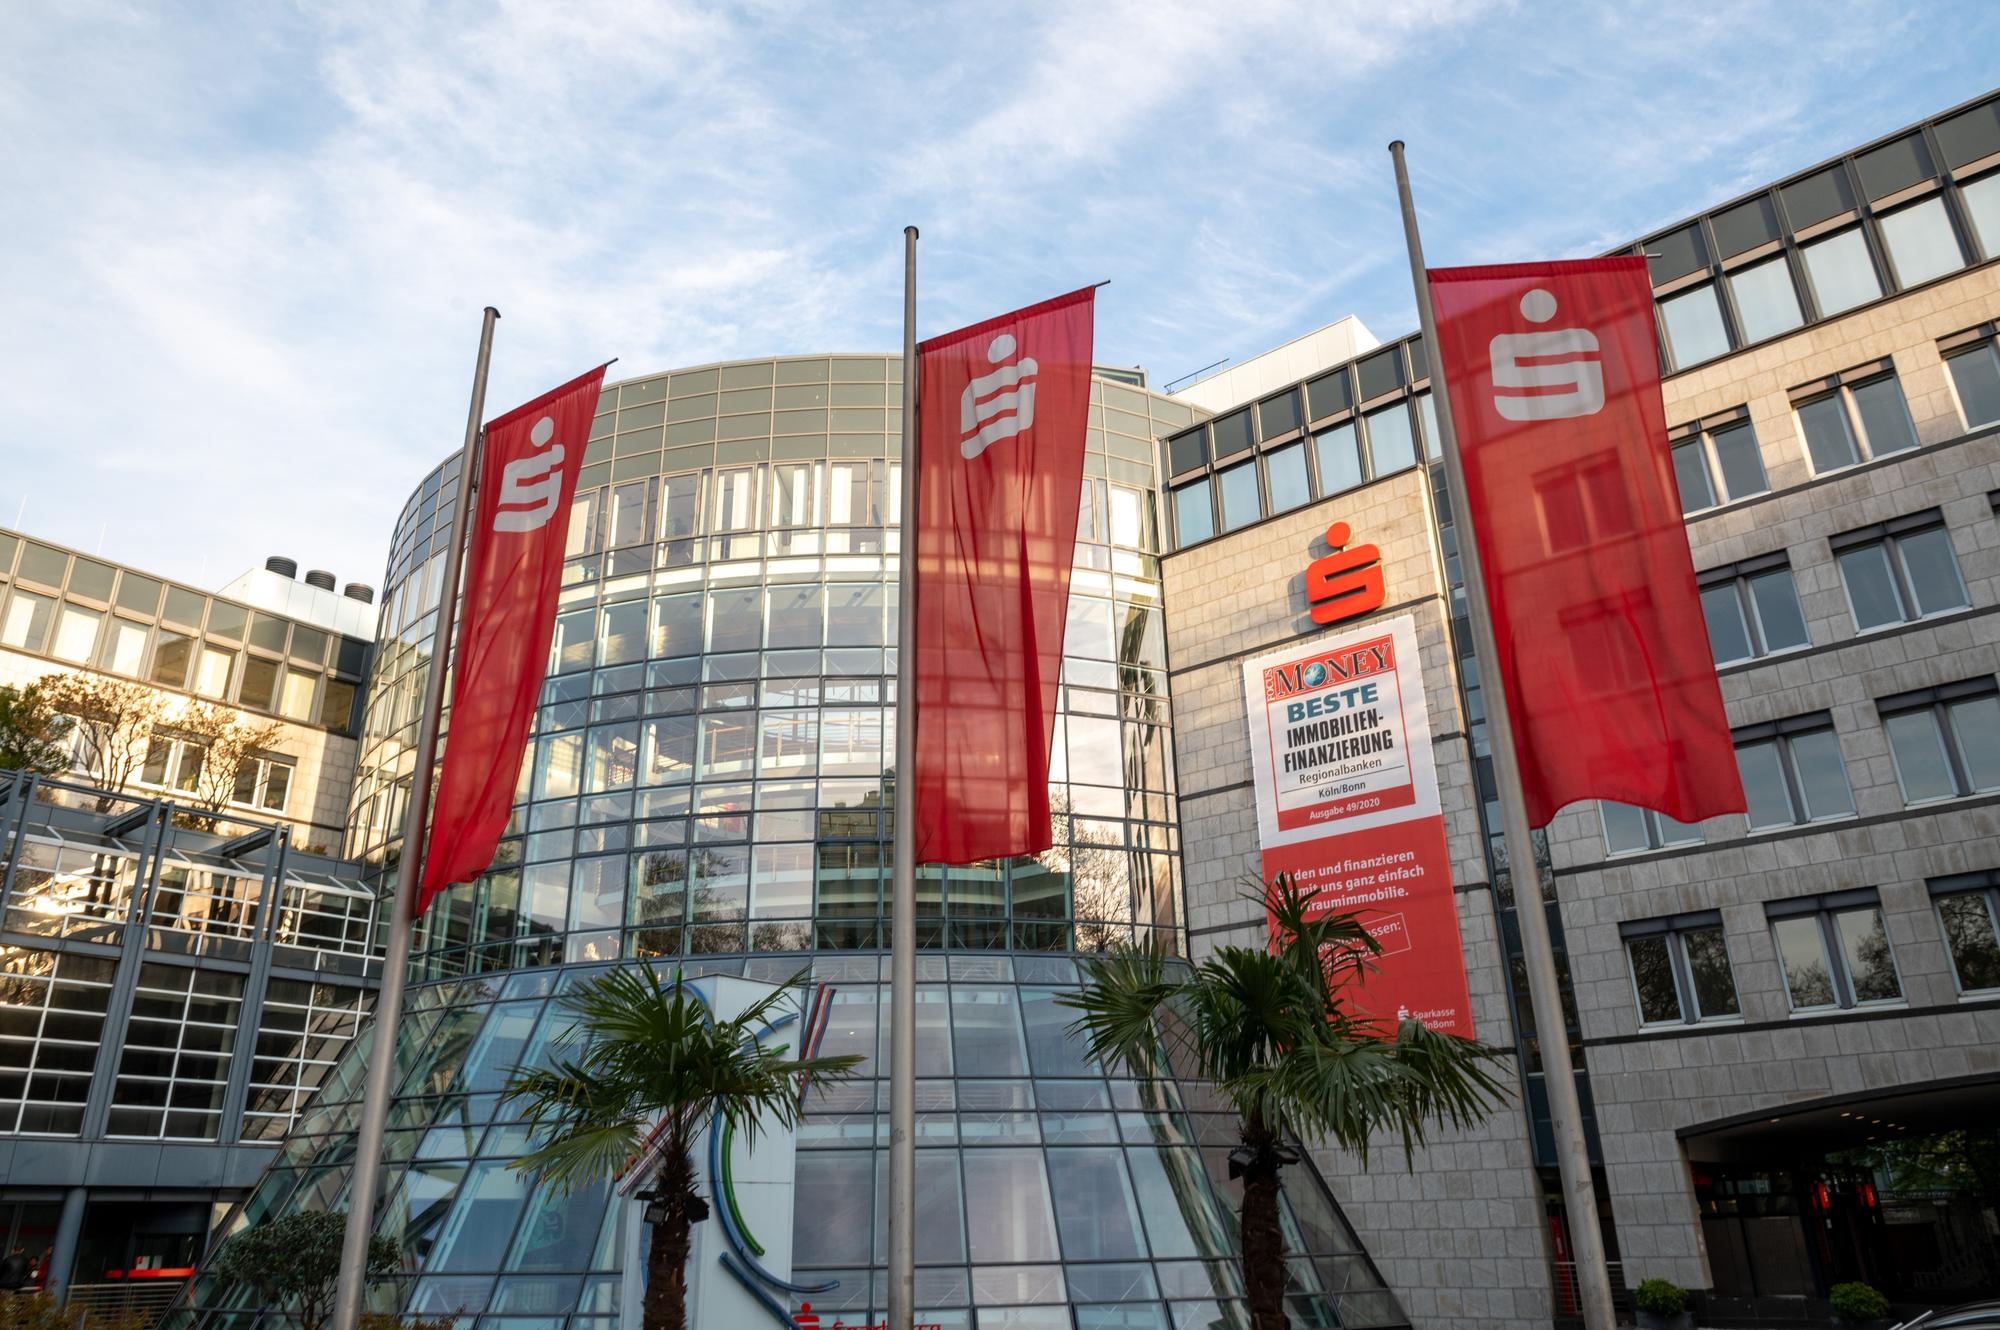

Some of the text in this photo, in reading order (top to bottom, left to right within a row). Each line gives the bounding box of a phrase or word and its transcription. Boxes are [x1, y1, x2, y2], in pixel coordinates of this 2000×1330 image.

[1277, 643, 1390, 696] MONEY
[1287, 682, 1379, 724] BESTE
[1287, 708, 1384, 748] IMMOBILIEN-
[1284, 729, 1394, 773] FINANZIERUNG
[1299, 758, 1382, 784] Regionalbanken
[1318, 781, 1366, 798] Köln/Bonn
[1309, 797, 1381, 820] Ausgabe 49/2020
[1319, 862, 1342, 877] und
[1344, 851, 1415, 871] finanzieren
[1321, 881, 1343, 892] uns
[1346, 875, 1376, 890] ganz
[1378, 865, 1425, 883] einfach
[1413, 1009, 1456, 1020] Sparkasse
